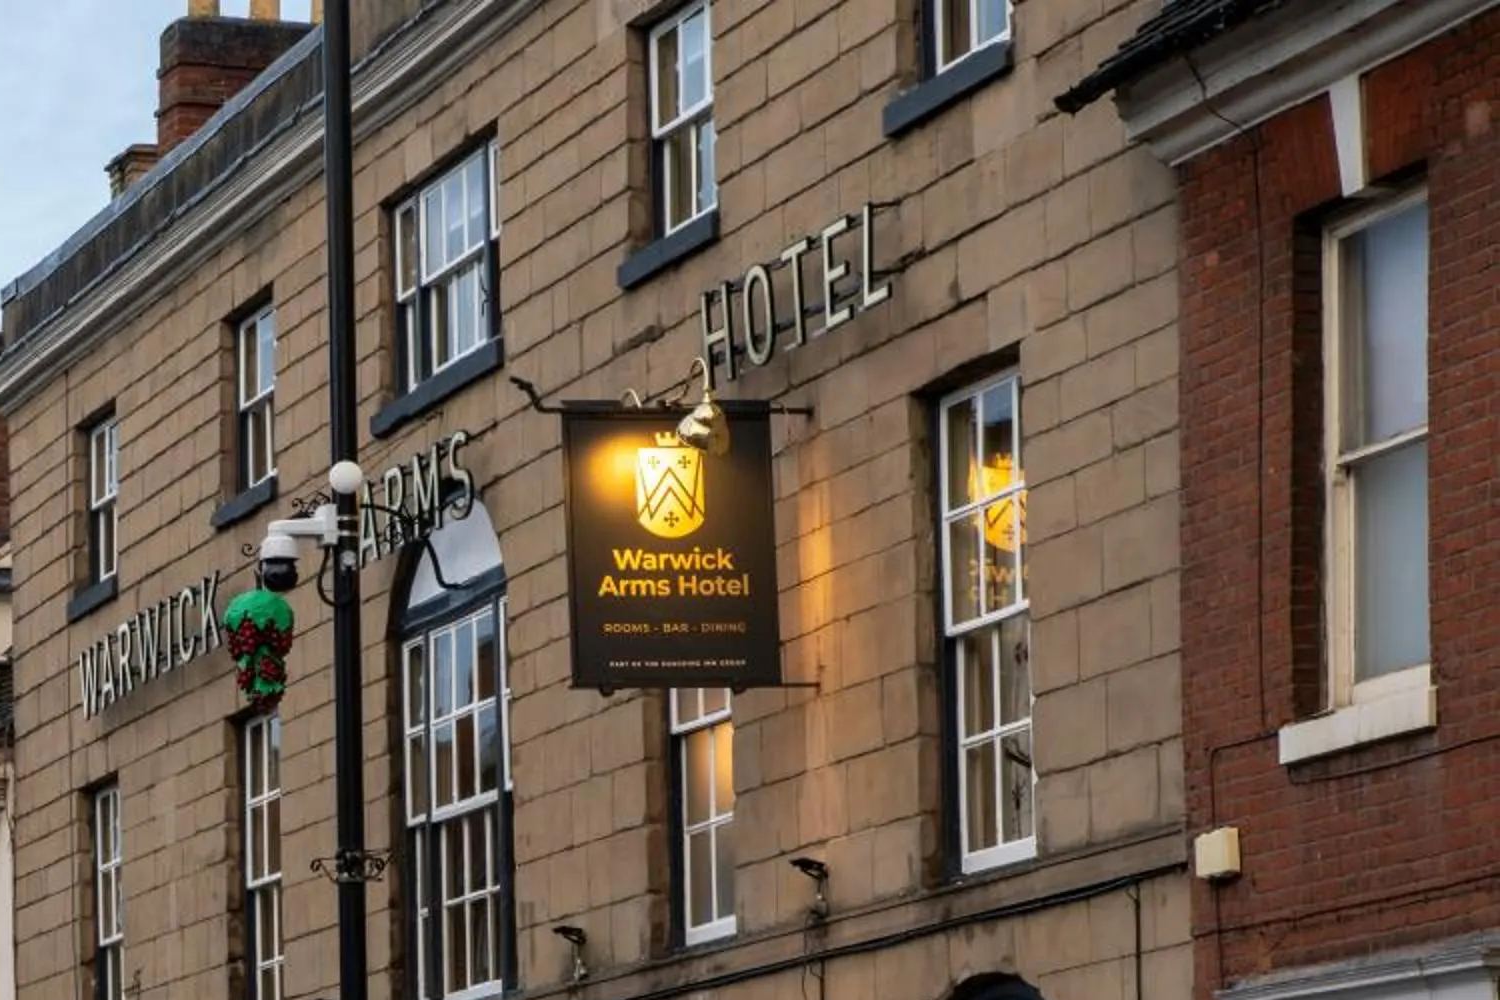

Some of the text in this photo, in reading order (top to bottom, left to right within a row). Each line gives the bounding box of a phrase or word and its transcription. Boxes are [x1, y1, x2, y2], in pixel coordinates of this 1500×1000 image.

[78, 202, 891, 720] WARWICK ARMS HOTEL
[612, 547, 734, 571] Warwick
[598, 574, 749, 597] Arms Hotel
[603, 623, 746, 633] ROOMS BAR DINING
